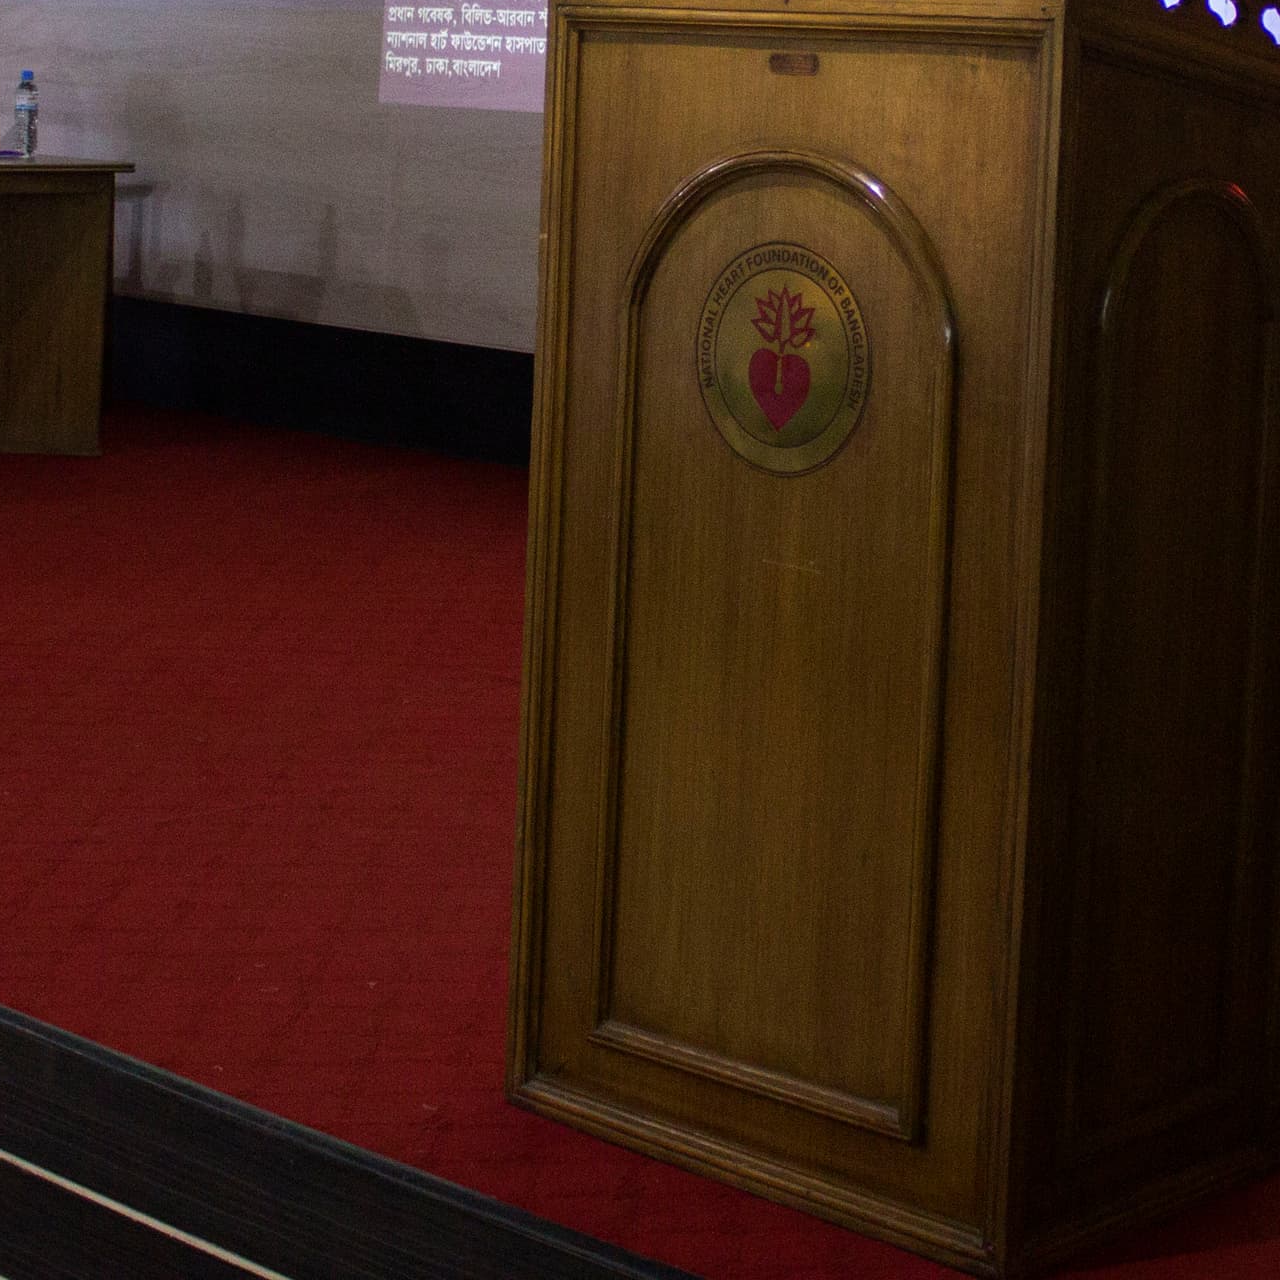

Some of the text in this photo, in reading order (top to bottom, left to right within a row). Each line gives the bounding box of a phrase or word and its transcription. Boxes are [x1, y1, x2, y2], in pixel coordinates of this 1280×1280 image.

[701, 249, 865, 411] NATIONAL HEART FOUNDATION OF BANGLADESH
